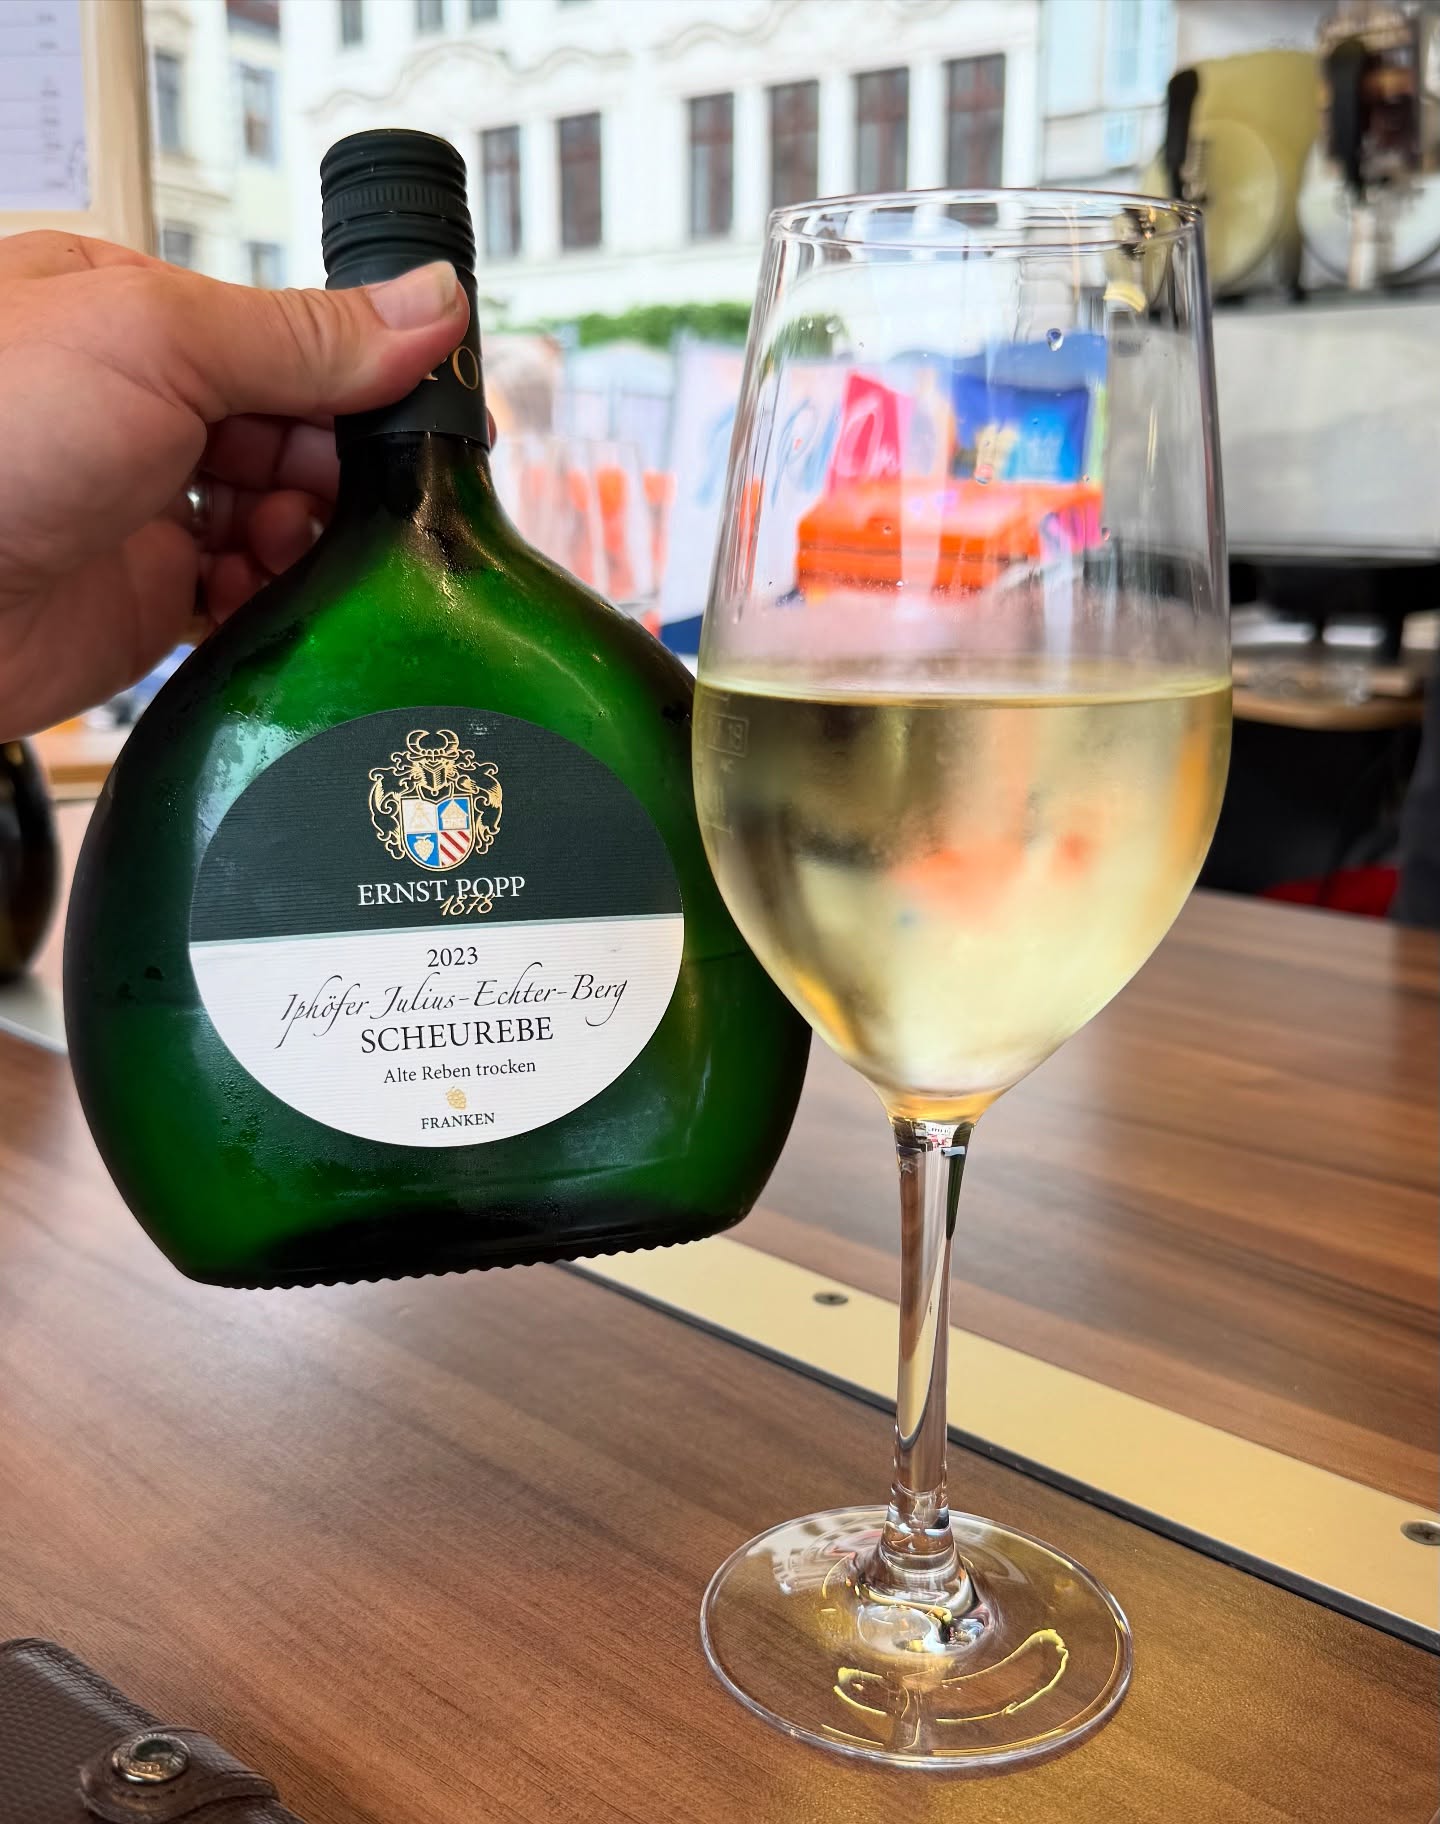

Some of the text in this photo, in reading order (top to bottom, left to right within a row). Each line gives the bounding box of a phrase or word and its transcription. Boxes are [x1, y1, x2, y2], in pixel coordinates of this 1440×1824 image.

[357, 876, 526, 906] ERNST POPP
[440, 893, 496, 916] 1878
[426, 946, 479, 968] 2023
[369, 961, 628, 1027] Julius-Echter-Berg
[361, 1016, 554, 1054] SCHEUREBE
[383, 1058, 537, 1084] Alte Reben trocken
[421, 1112, 496, 1130] FRANKEN
